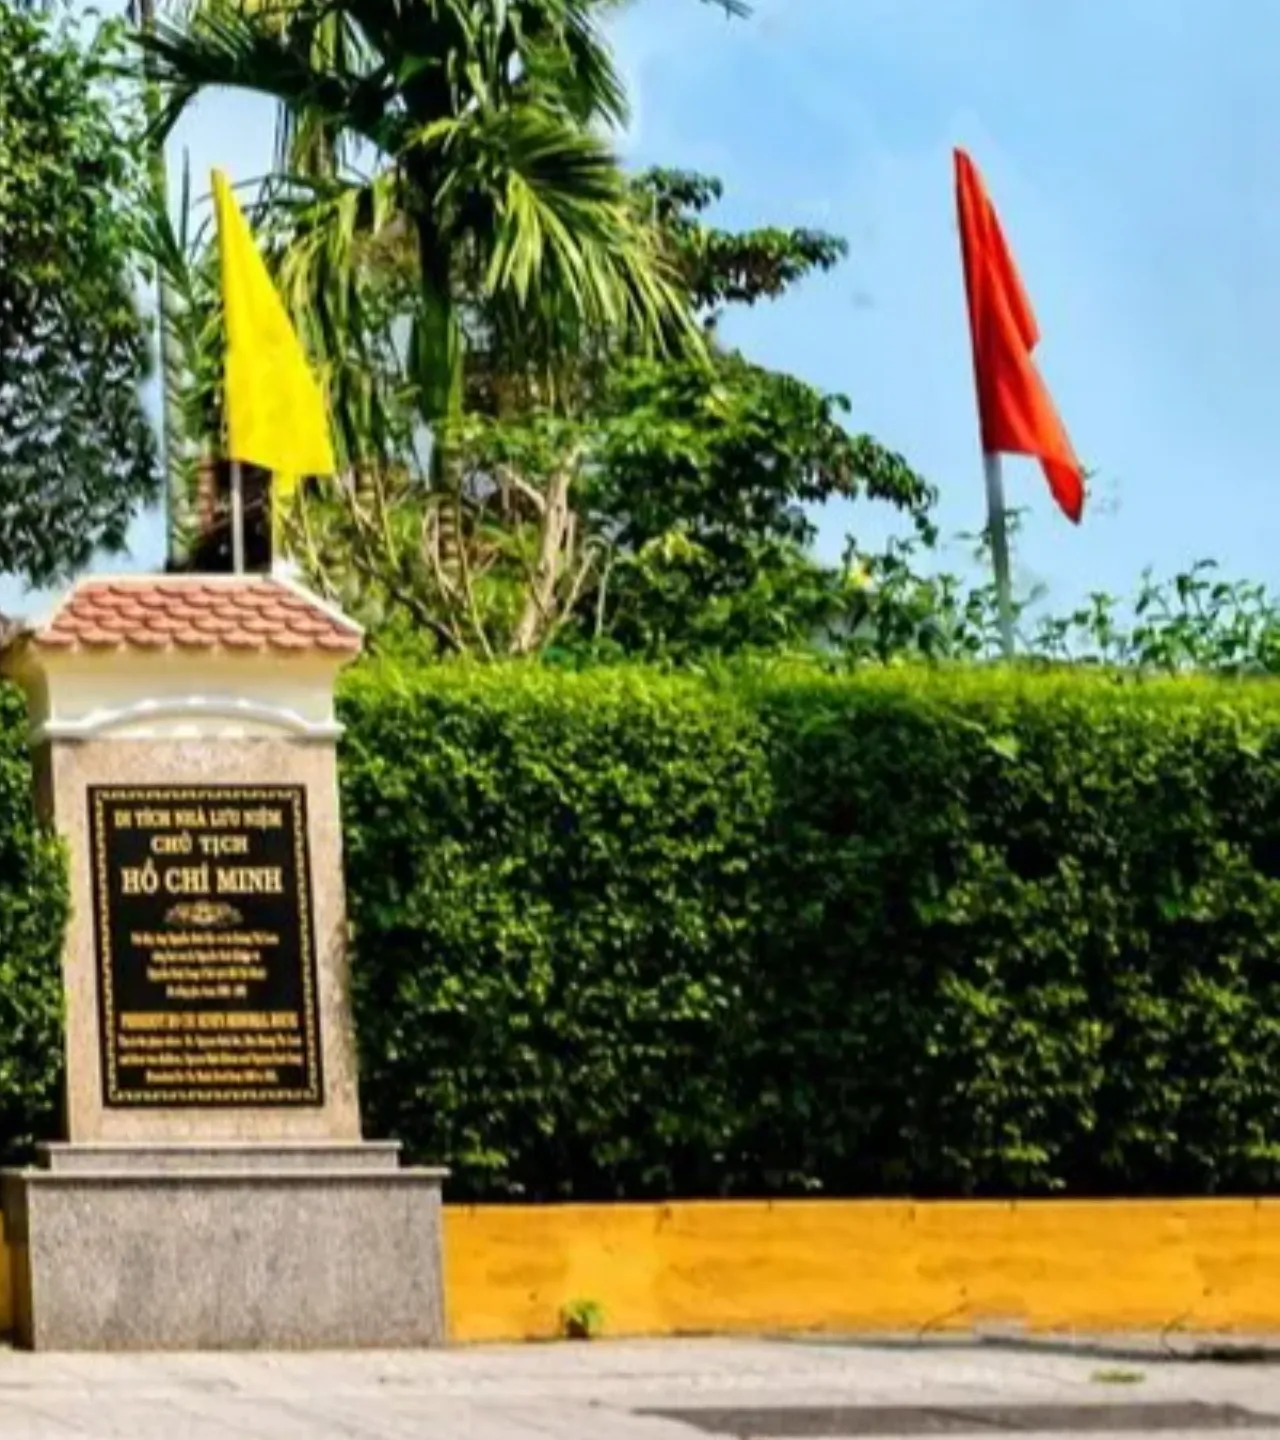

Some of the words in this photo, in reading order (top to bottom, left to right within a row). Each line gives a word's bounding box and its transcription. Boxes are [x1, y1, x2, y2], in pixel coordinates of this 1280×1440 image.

[113, 808, 132, 828] DI
[135, 806, 171, 828] TÍCH
[175, 805, 206, 828] NHÀ
[210, 808, 240, 828] LƯU
[150, 830, 193, 855] CHỦ
[199, 835, 248, 859] TỊCH
[121, 857, 159, 895] HỒ
[165, 861, 210, 894] CHÍ
[216, 866, 283, 894] MINH
